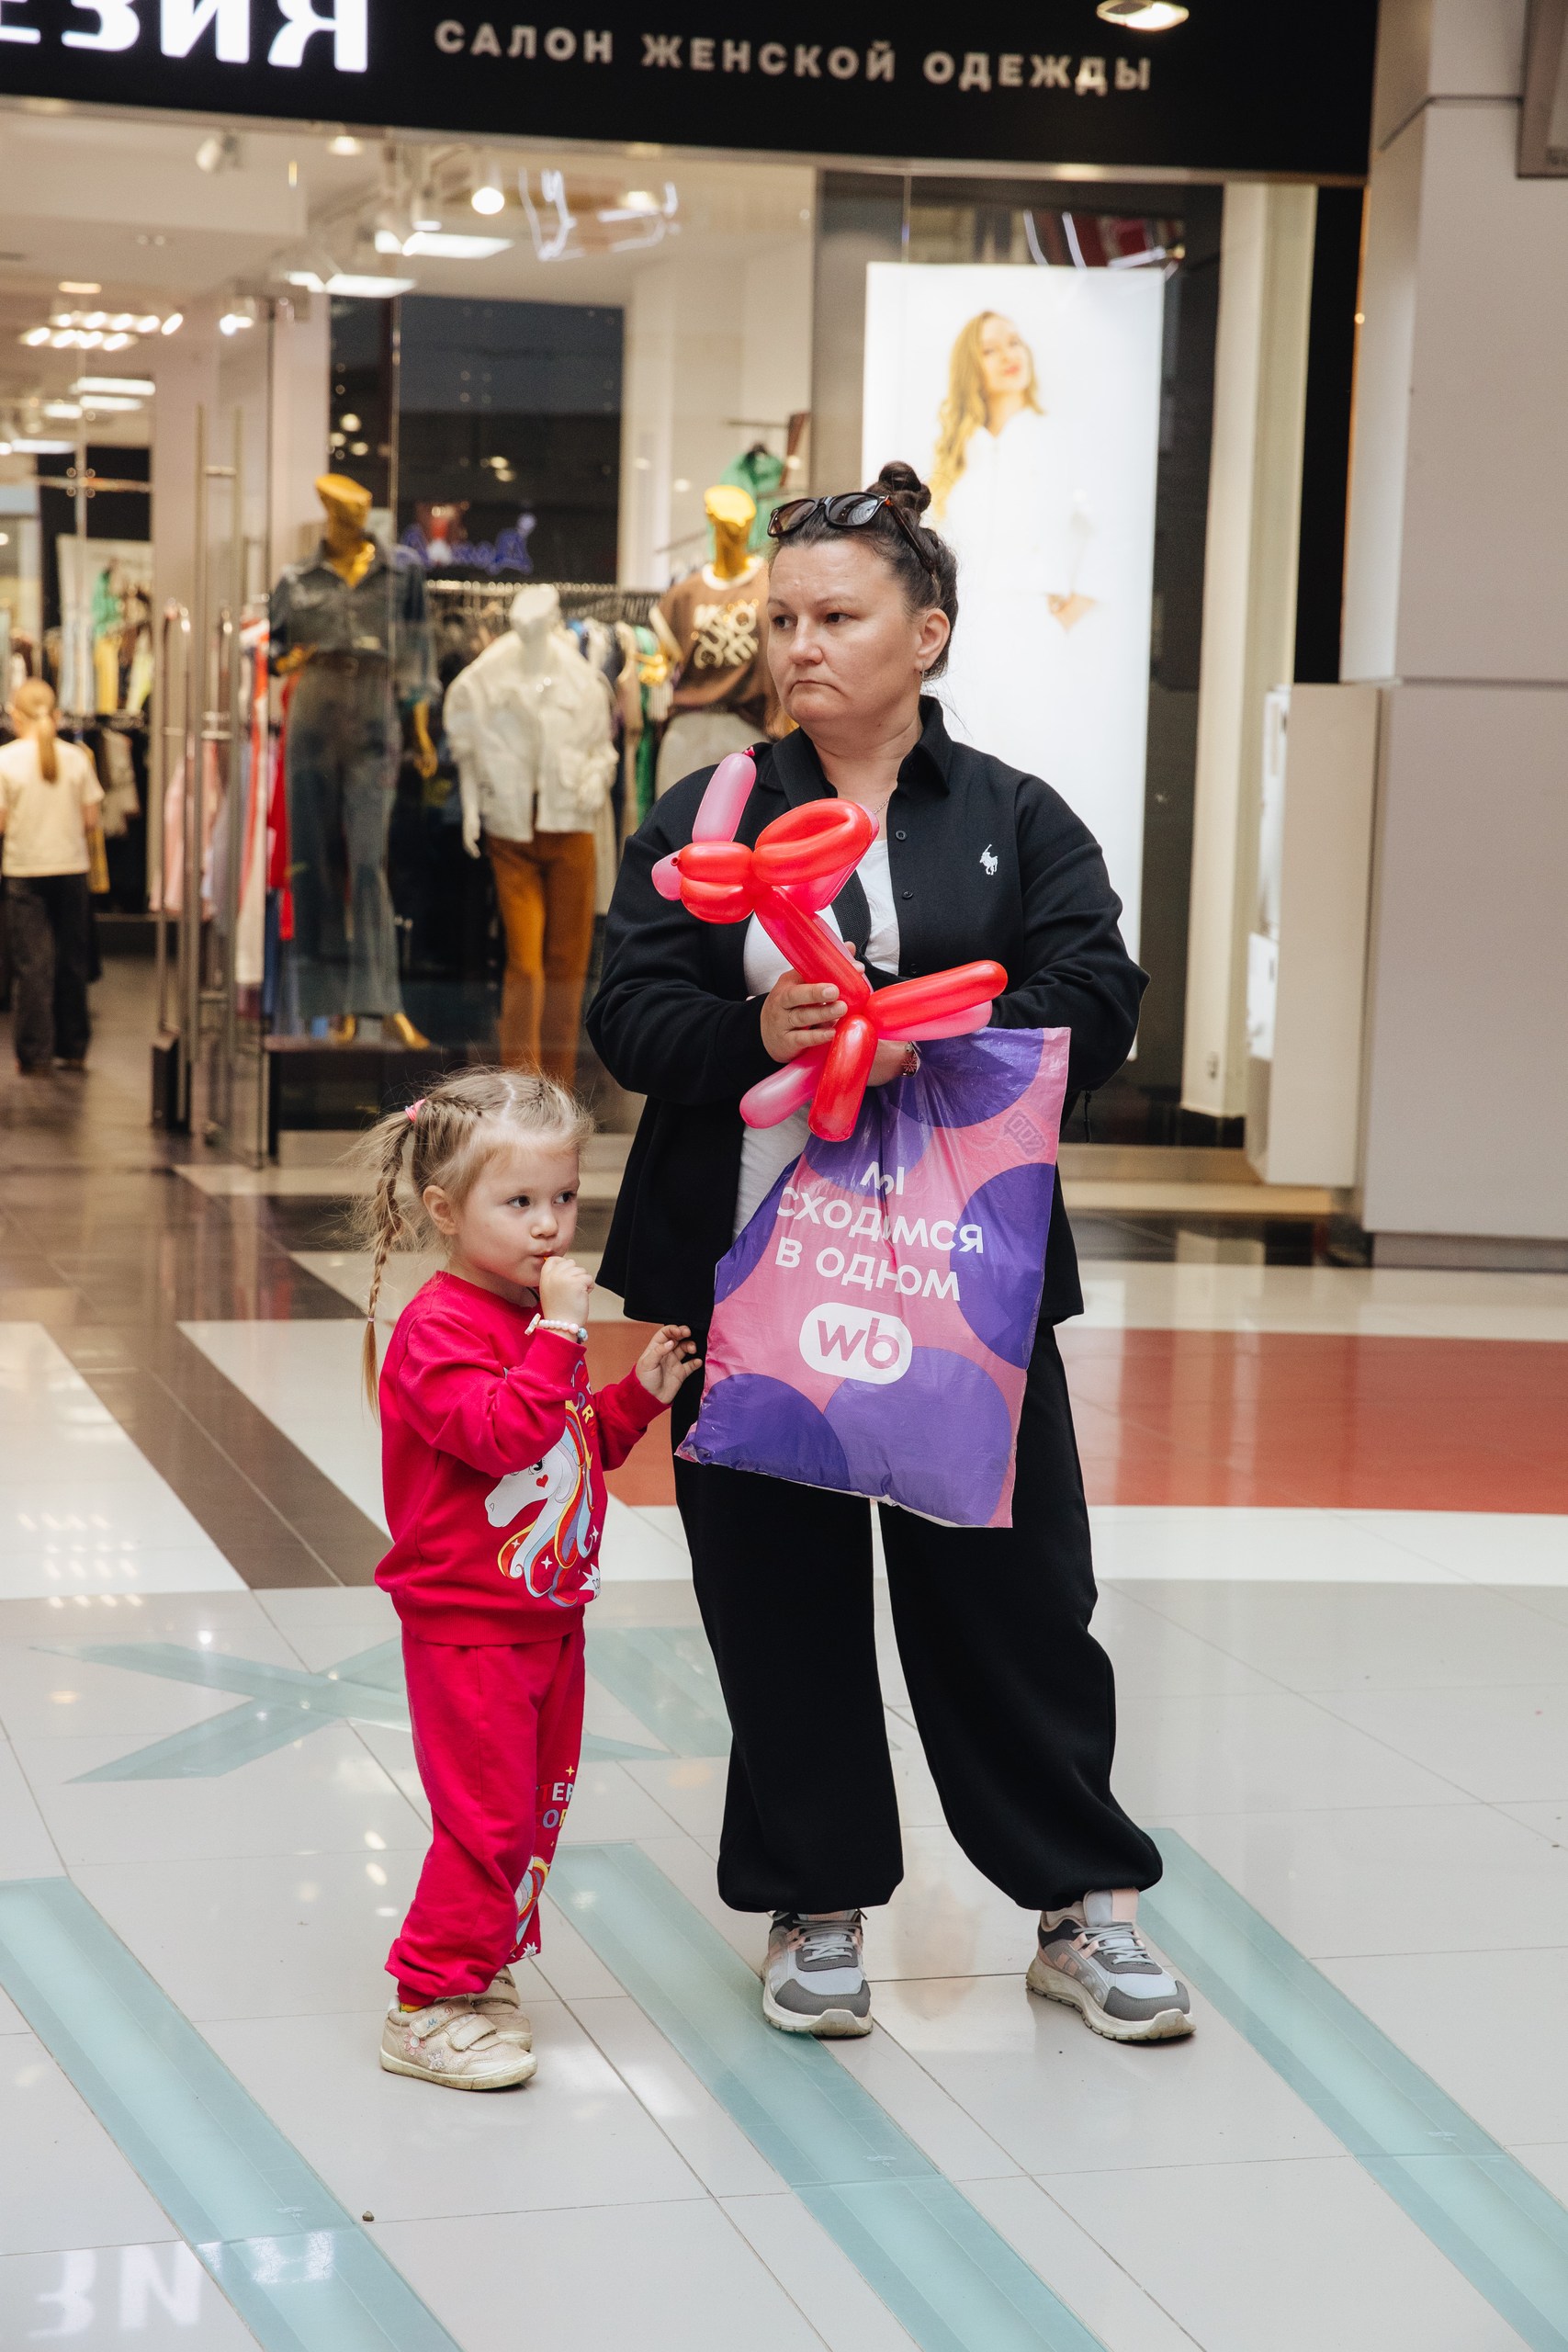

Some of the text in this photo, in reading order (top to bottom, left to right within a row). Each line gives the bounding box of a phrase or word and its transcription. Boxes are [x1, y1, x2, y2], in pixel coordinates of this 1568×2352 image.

[435, 20, 1150, 96] САЛОН ЖЕНСКОЙ ОДЕЖДЫ
[775, 1237, 961, 1301] В ОДНОМ
[818, 1317, 900, 1369] wb
